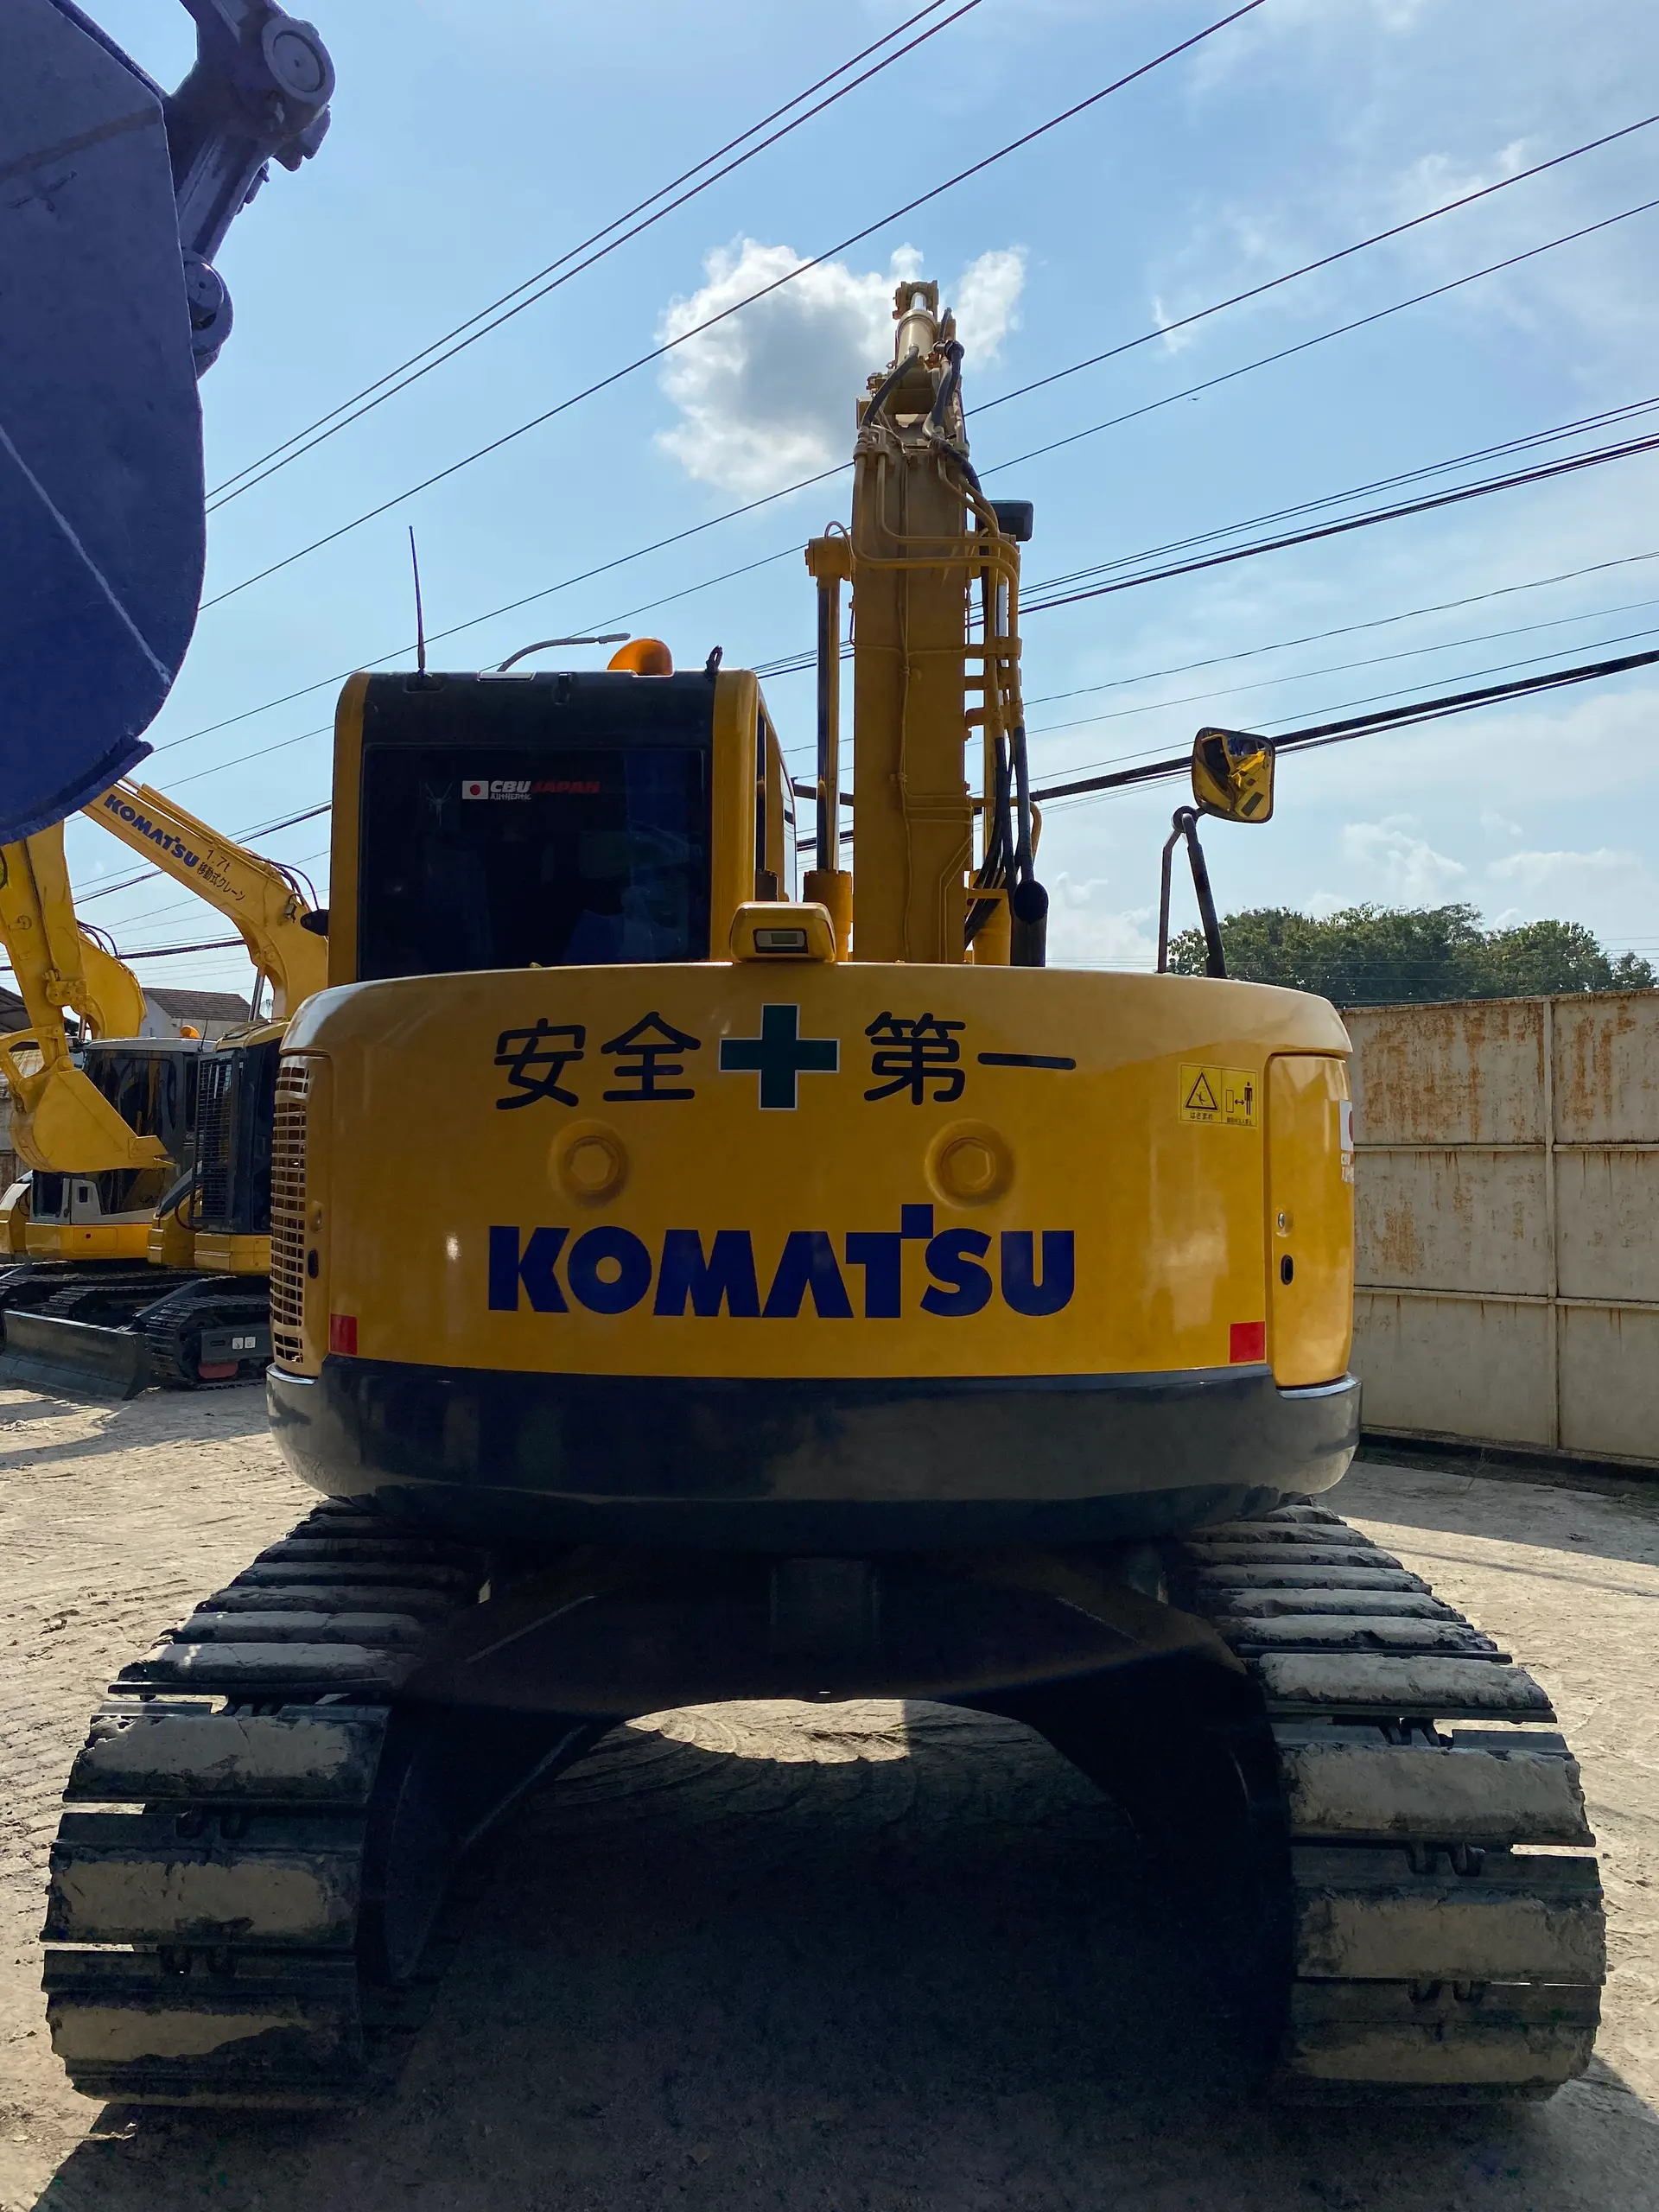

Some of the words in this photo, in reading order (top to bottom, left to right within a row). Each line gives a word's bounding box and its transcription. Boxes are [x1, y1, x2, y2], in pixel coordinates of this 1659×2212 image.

[490, 780, 531, 792] CBU
[532, 780, 601, 793] JAPAN
[104, 794, 200, 868] KOMATSU
[197, 861, 245, 901] 移動式クレーン
[207, 849, 231, 873] 1.7t
[493, 1011, 702, 1110] 安全
[864, 1011, 1077, 1106] 第一
[488, 1205, 1076, 1319] KOMATSU
